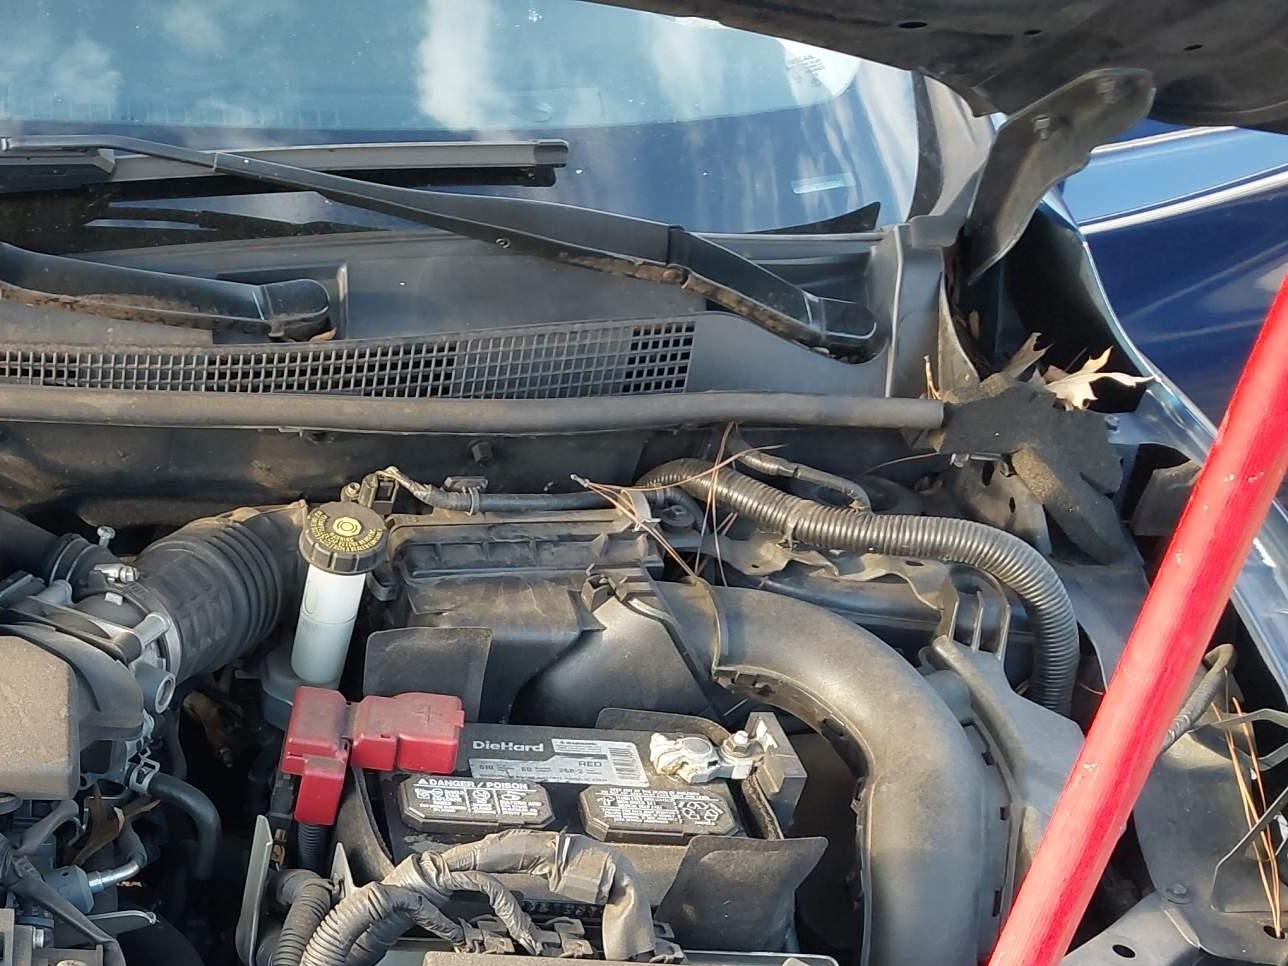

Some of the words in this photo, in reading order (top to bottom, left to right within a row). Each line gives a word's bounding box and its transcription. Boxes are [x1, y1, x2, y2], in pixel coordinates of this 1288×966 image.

[472, 740, 544, 752] DieHard
[578, 760, 602, 768] RED
[428, 779, 475, 788] DANGER
[485, 781, 528, 790] POISON
